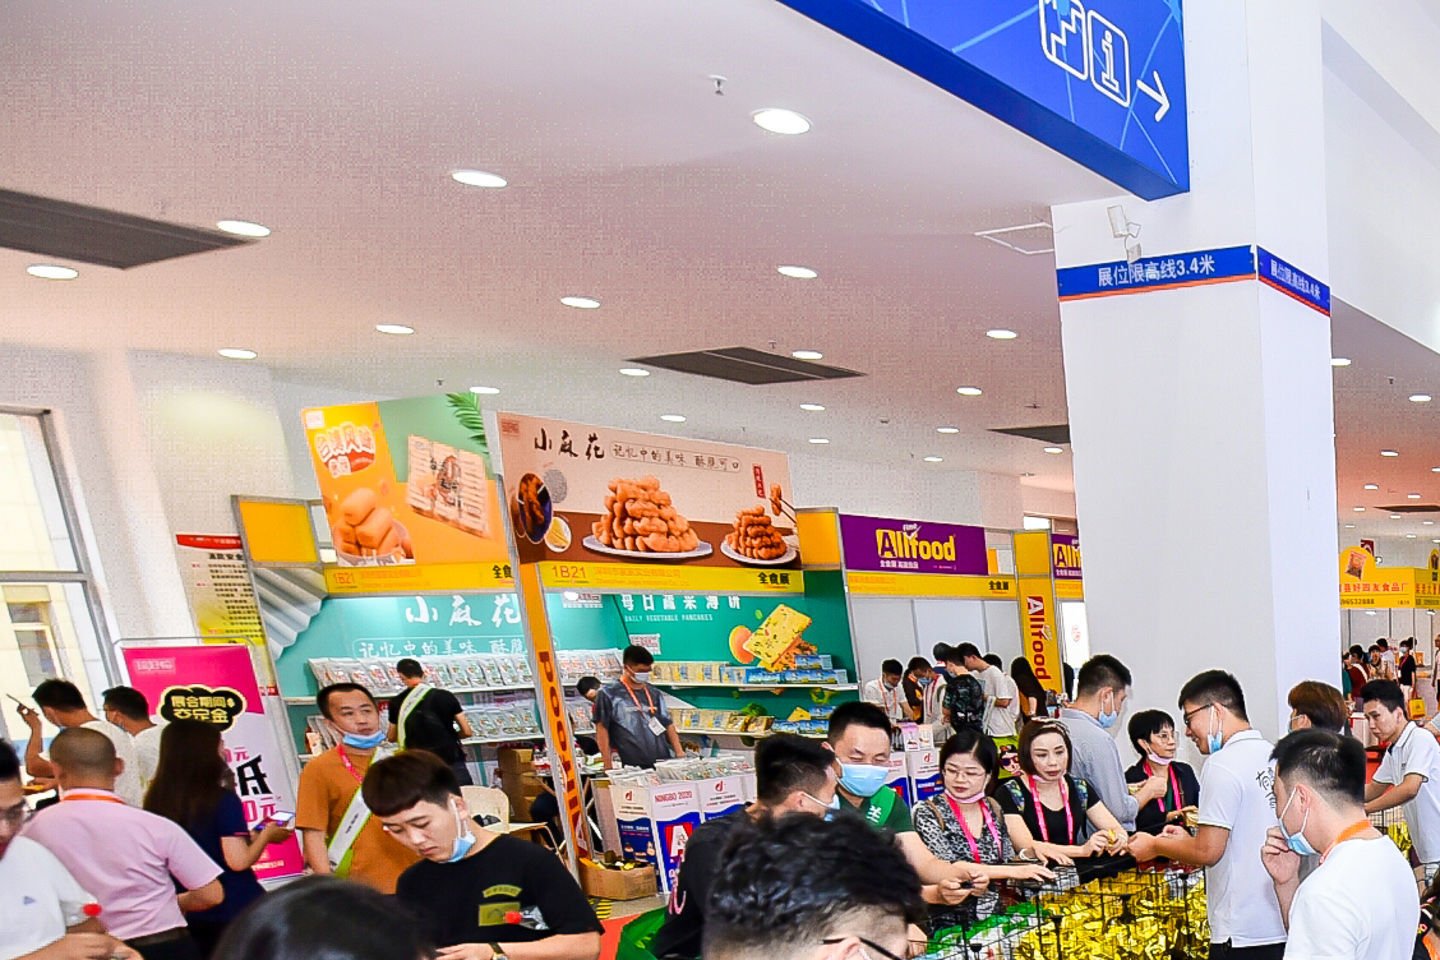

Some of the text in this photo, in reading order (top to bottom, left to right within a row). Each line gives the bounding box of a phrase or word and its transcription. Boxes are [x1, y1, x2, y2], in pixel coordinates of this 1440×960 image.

[1098, 254, 1216, 287] 展位限高线3.4米
[534, 428, 605, 461] 小麻花
[612, 444, 686, 466] 记忆中的美味
[876, 528, 956, 562] Allfood
[552, 566, 587, 579] 1B21
[757, 572, 790, 585] 全食展
